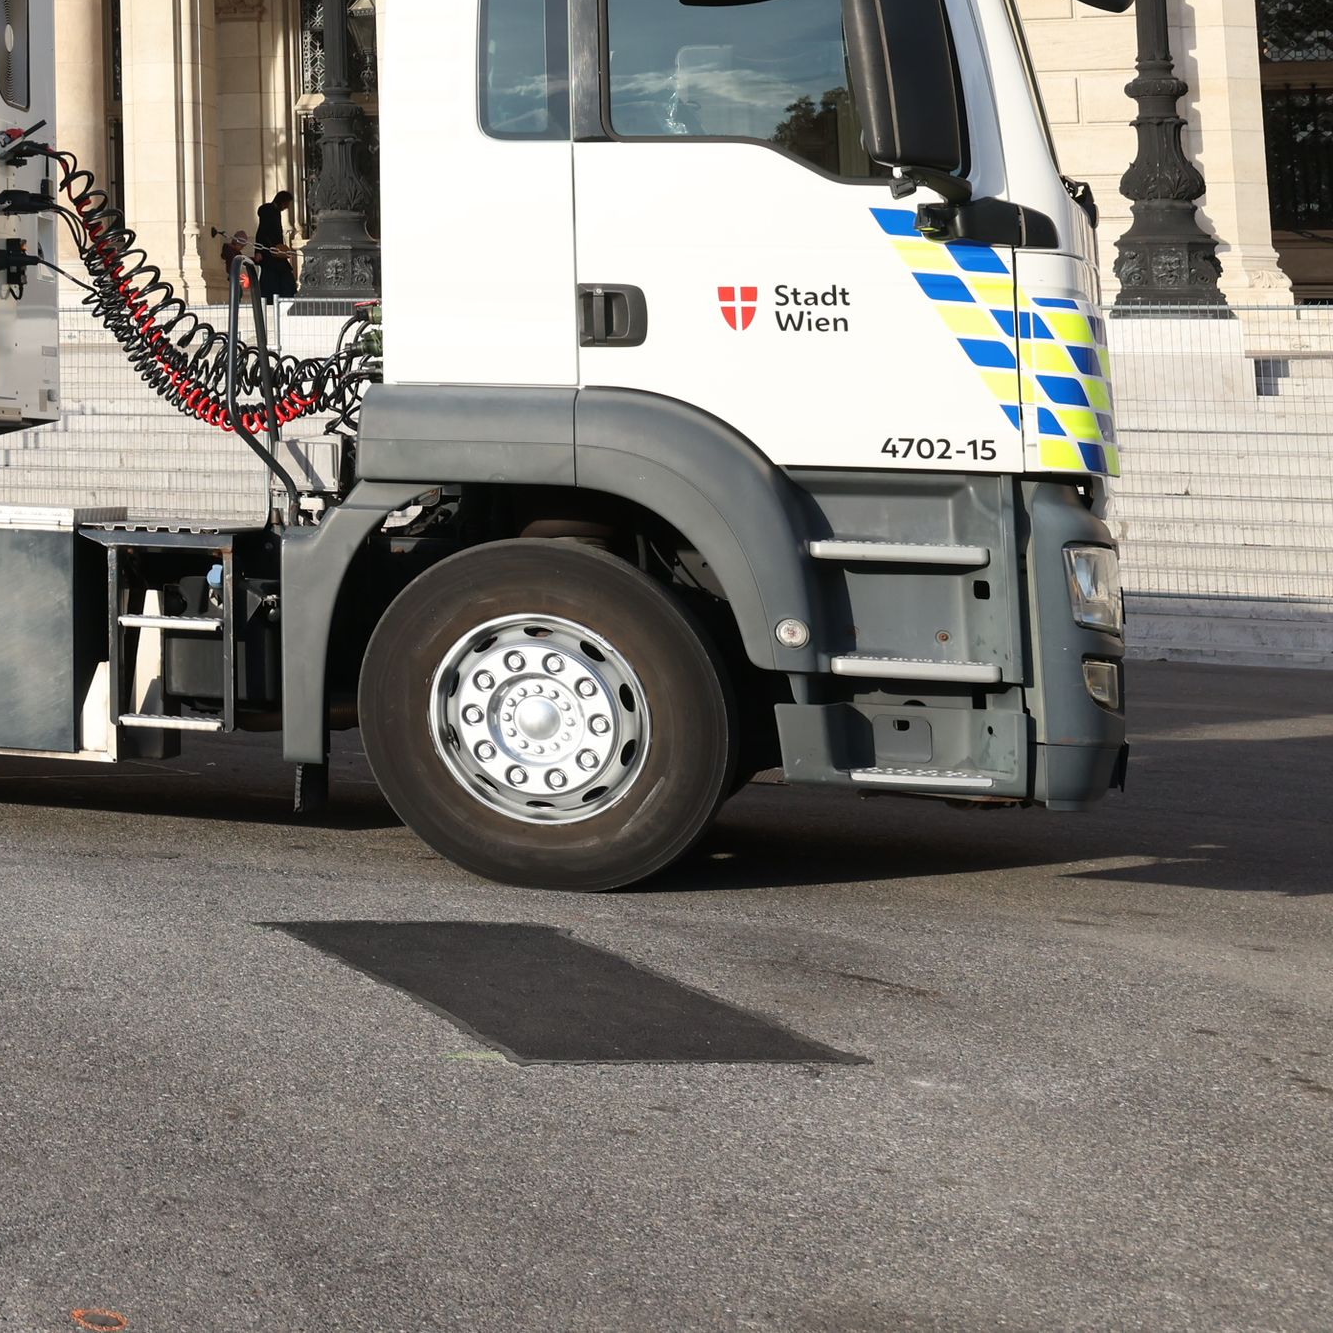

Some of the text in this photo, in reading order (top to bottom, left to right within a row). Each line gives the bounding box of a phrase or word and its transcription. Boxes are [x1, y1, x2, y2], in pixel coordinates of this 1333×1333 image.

[774, 284, 851, 307] Stadt
[775, 310, 849, 332] Wien
[880, 437, 997, 461] 4702-15
